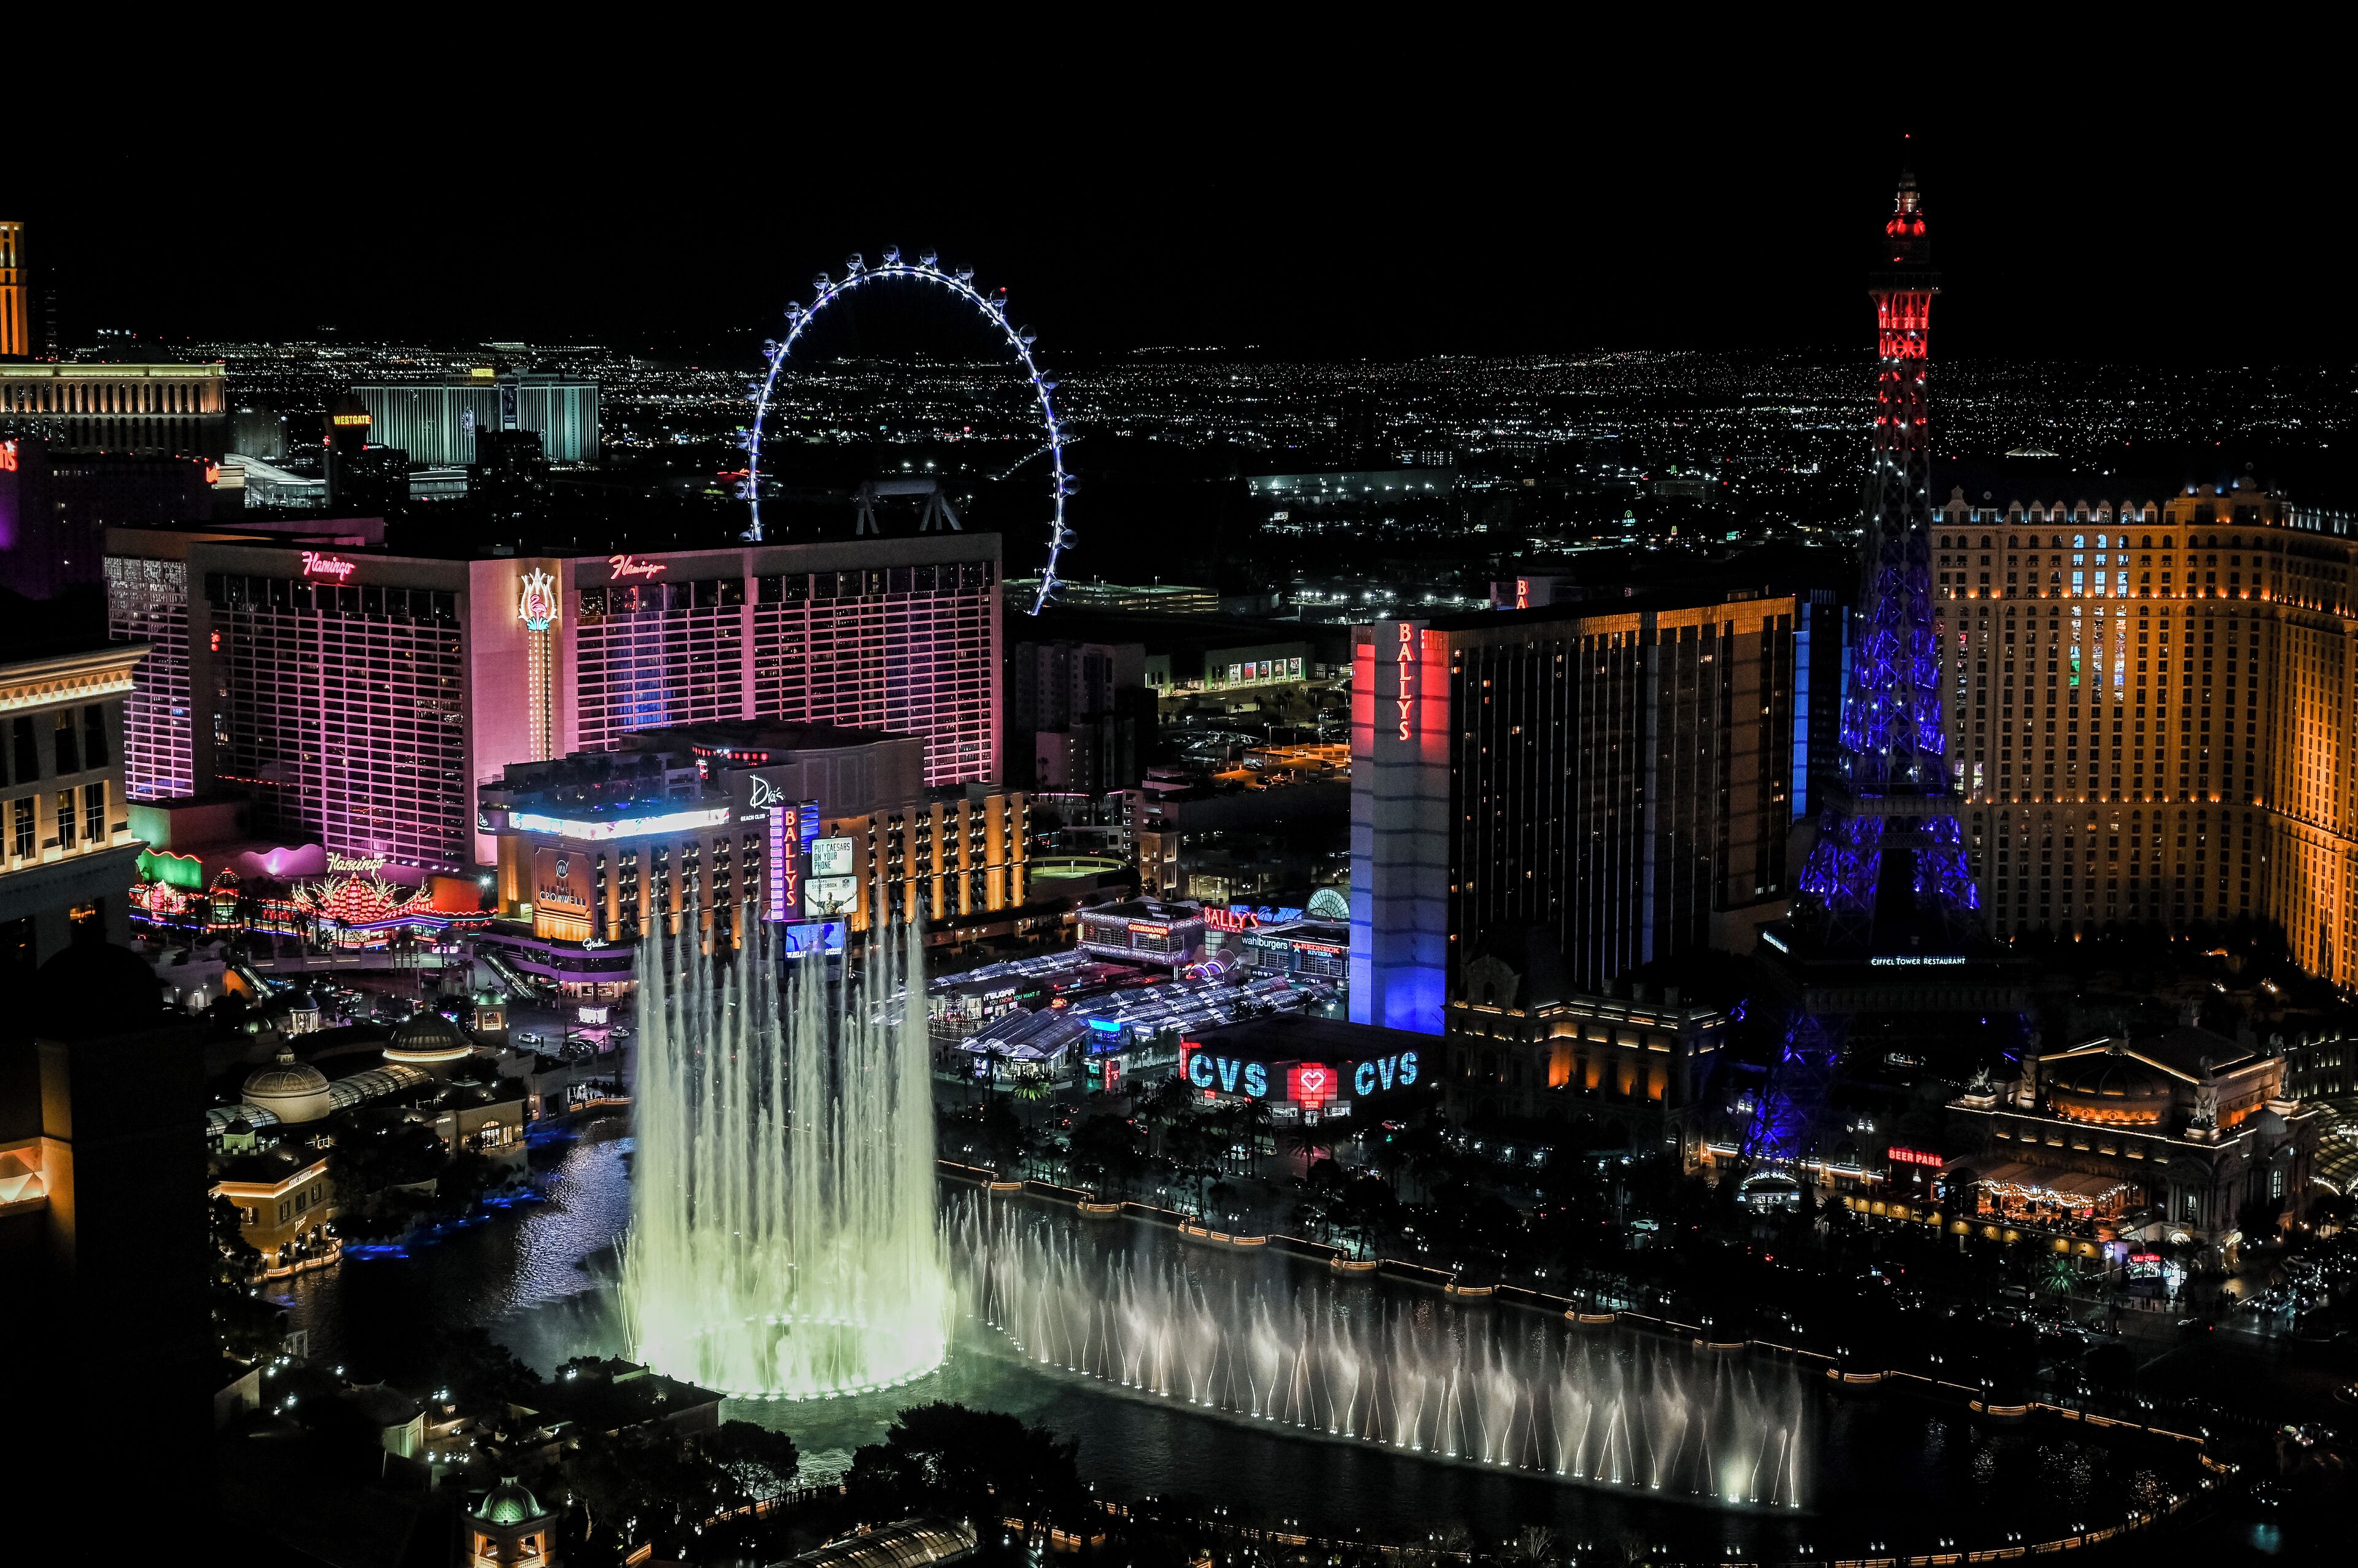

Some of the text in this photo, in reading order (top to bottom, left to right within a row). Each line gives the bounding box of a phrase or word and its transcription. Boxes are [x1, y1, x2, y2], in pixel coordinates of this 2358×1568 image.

[334, 415, 371, 425] WESTGATE
[302, 551, 356, 581] Flamingo
[609, 555, 667, 580] Flamingo
[1396, 623, 1413, 740] BALLYS
[749, 774, 784, 809] Drai's
[814, 842, 850, 853] PUT CAESARS
[326, 852, 386, 876] Flamingo
[785, 810, 797, 907] BALLYS
[823, 852, 838, 861] YOUR
[814, 861, 831, 870] PHONE
[540, 891, 586, 907] CROMWELL
[1205, 906, 1259, 929] BALLY'S
[1128, 924, 1167, 934] GIORDANO'S
[583, 937, 609, 951] Giada
[1242, 936, 1288, 950] wahlburgers
[1301, 944, 1340, 953] REDNECK
[1189, 1054, 1267, 1096] CVS
[1355, 1051, 1418, 1096] CVS
[1889, 1149, 1942, 1166] BEER PARK
